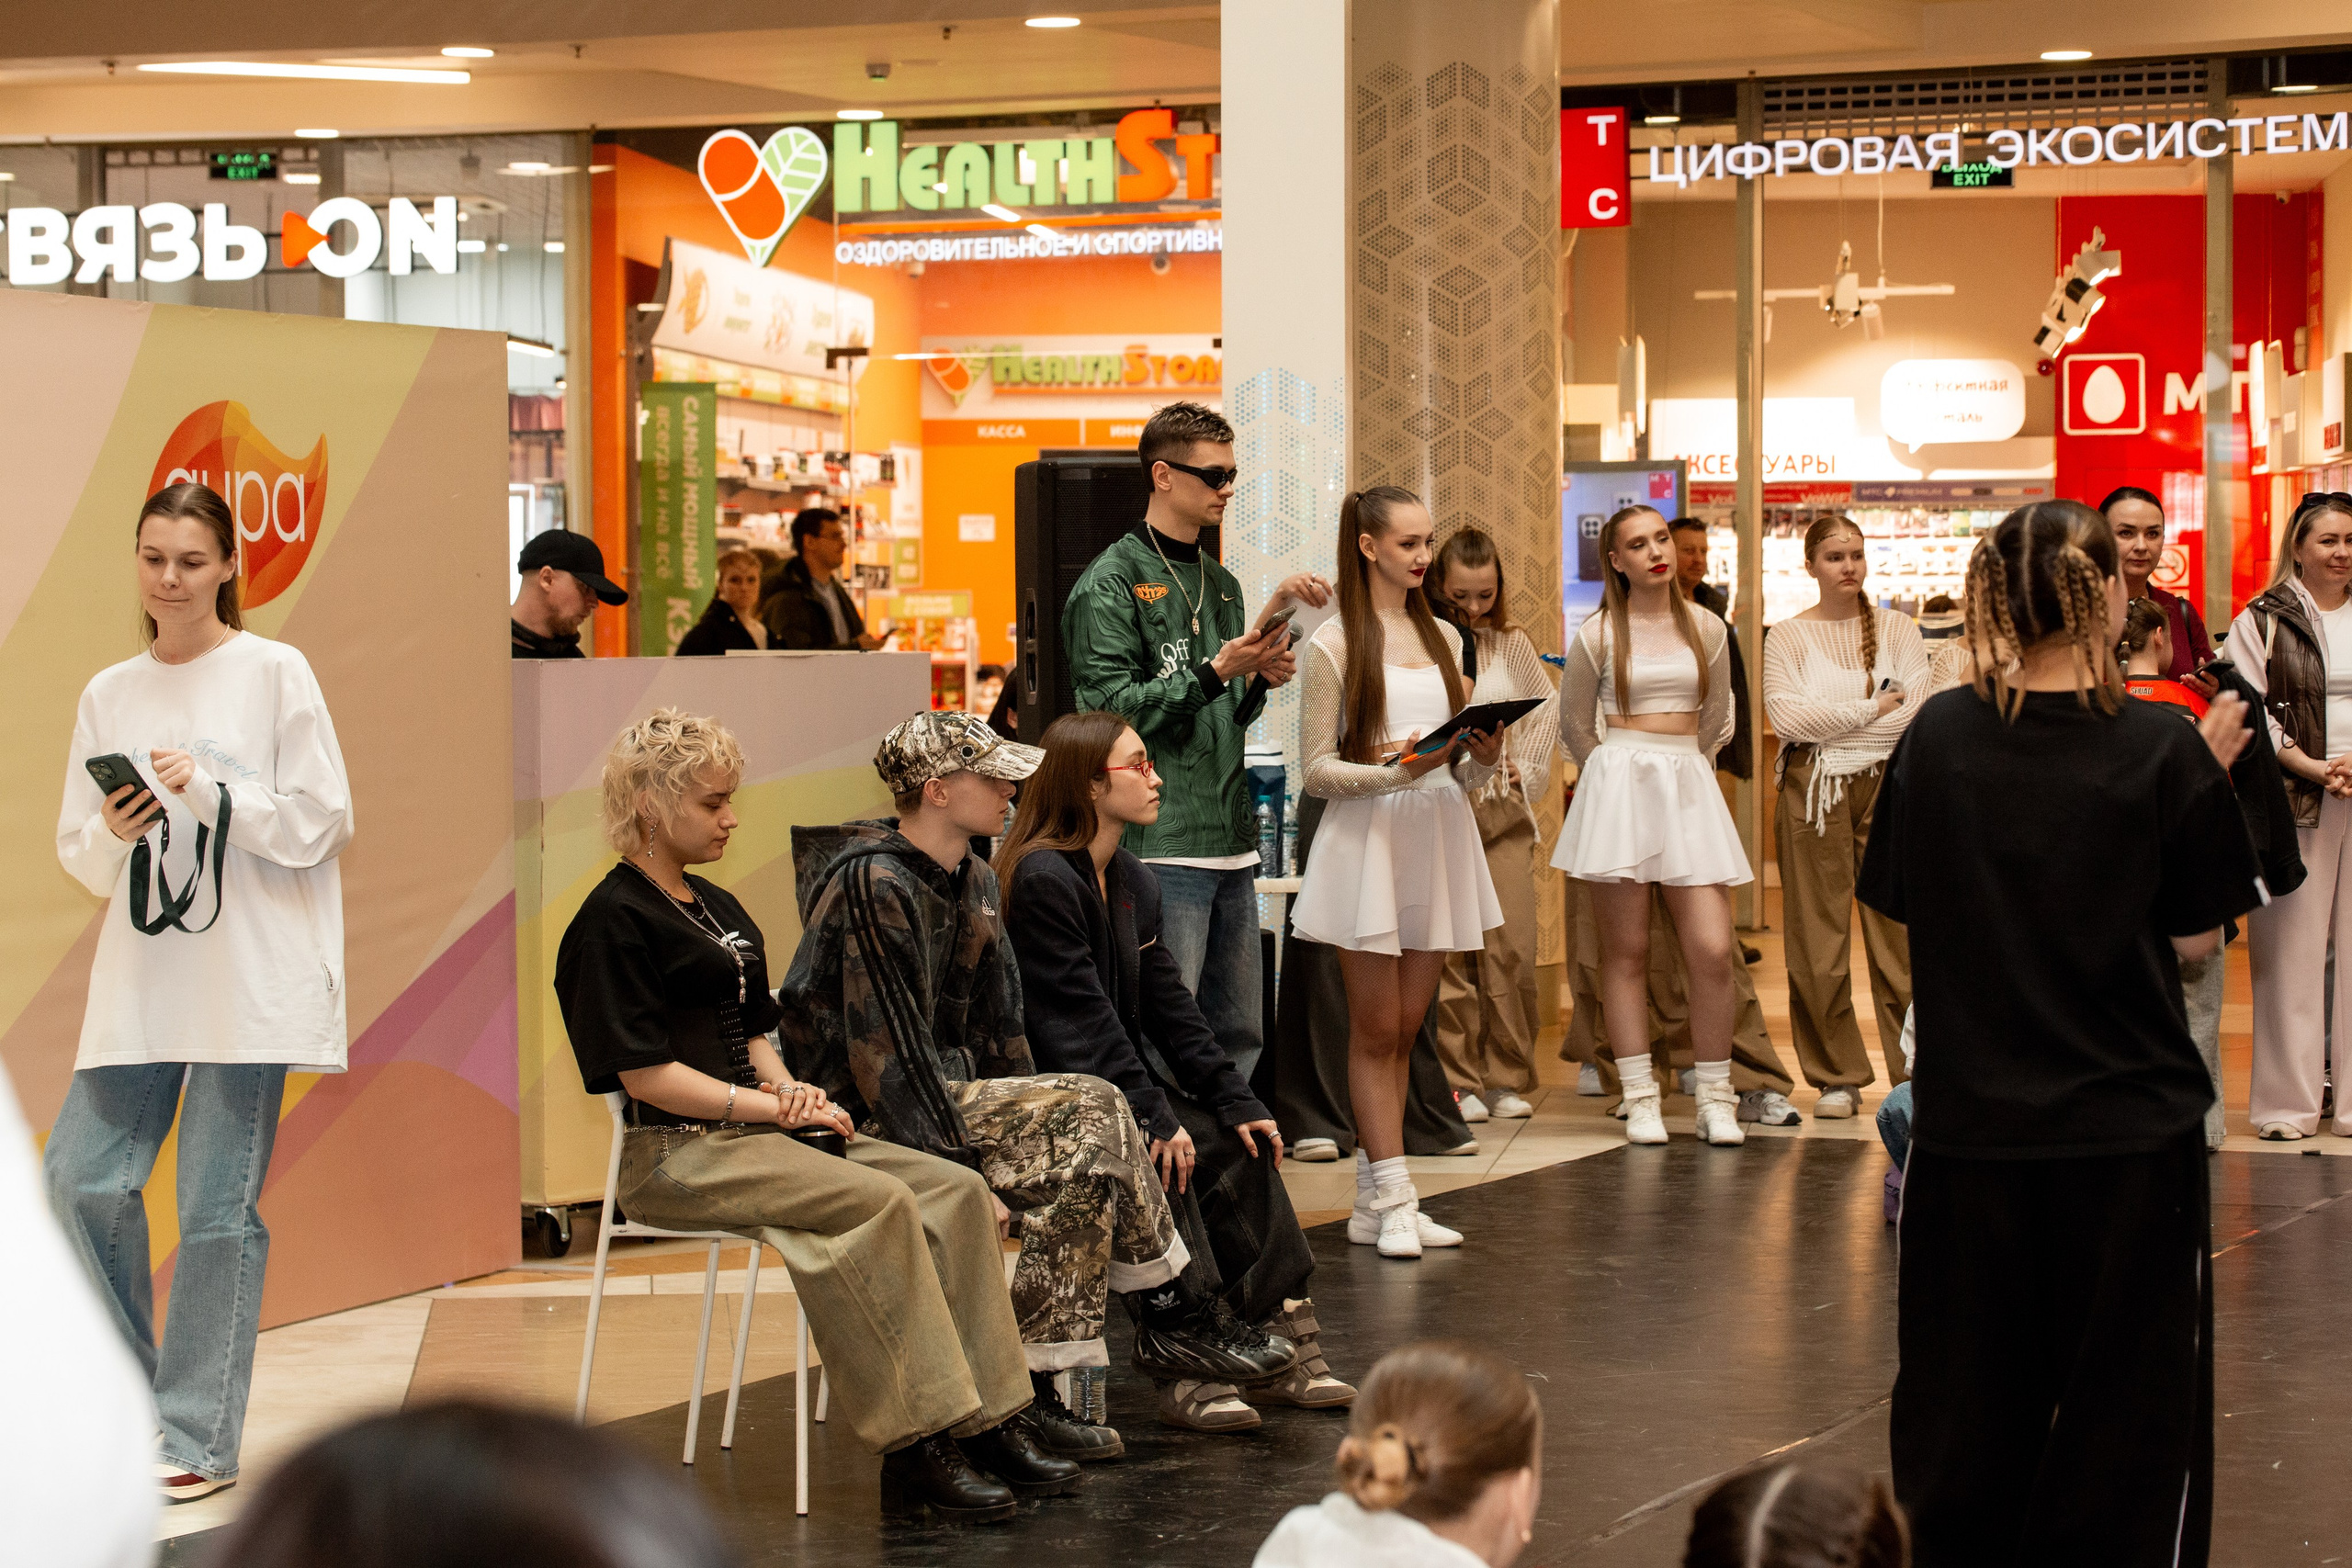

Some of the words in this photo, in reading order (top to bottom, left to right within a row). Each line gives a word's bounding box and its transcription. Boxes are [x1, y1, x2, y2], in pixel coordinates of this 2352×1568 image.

[1649, 132, 1961, 188] ЦИФРОВАЯ
[1985, 111, 2348, 169] ЭКОСИСТЕМ
[1953, 173, 1991, 186] EXIT
[0, 202, 268, 286] ВЯЗЬ
[307, 196, 458, 278] ON
[835, 235, 1068, 266] ОЗДОРОВИТЕЛЬНОЕ
[1072, 234, 1091, 256] И
[1097, 229, 1222, 255] СПОРТИВН
[681, 396, 703, 479] САМЫЙ
[977, 424, 1027, 439] КАССА
[1673, 454, 1836, 474] КСЕУАРЫ
[164, 468, 305, 577] ра
[655, 507, 671, 535] на
[681, 482, 703, 590] МОЩНЫЙ
[666, 597, 693, 656] КЭ
[190, 739, 258, 780] Travel
